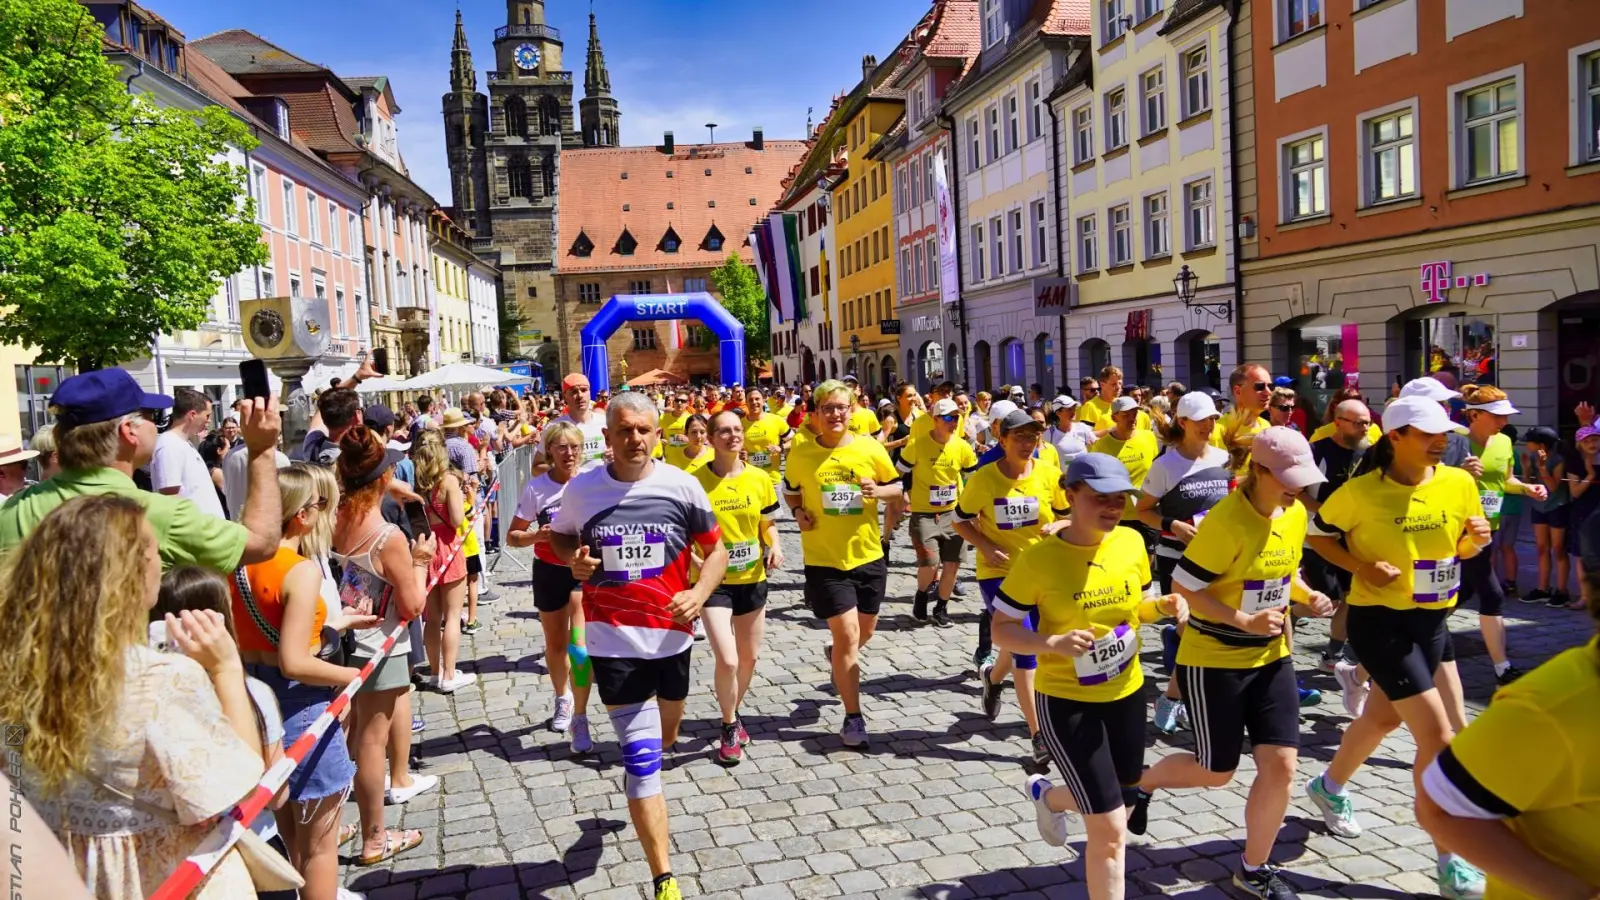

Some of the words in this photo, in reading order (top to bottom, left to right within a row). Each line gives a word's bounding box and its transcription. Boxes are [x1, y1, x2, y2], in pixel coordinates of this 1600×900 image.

[636, 302, 687, 316] START
[584, 441, 598, 450] 112
[1179, 479, 1228, 492] INNOVATIVE
[714, 497, 740, 506] CITYLAUF
[831, 491, 855, 502] 2357
[720, 503, 747, 511] ANSBACH
[1003, 504, 1030, 515] 1316
[1394, 514, 1433, 525] CITYLAUF
[591, 523, 676, 540] INNOVATIVE
[1402, 523, 1441, 533] ANSBACH
[616, 545, 652, 560] 1312
[728, 546, 752, 560] 2451
[1258, 549, 1287, 559] CITYLAUF
[1264, 559, 1292, 568] ANSBACH
[1072, 586, 1115, 601] CITYLAUF
[1256, 587, 1285, 603] 1492
[1083, 595, 1125, 611] ANSBACH
[1089, 639, 1126, 664] 1280
